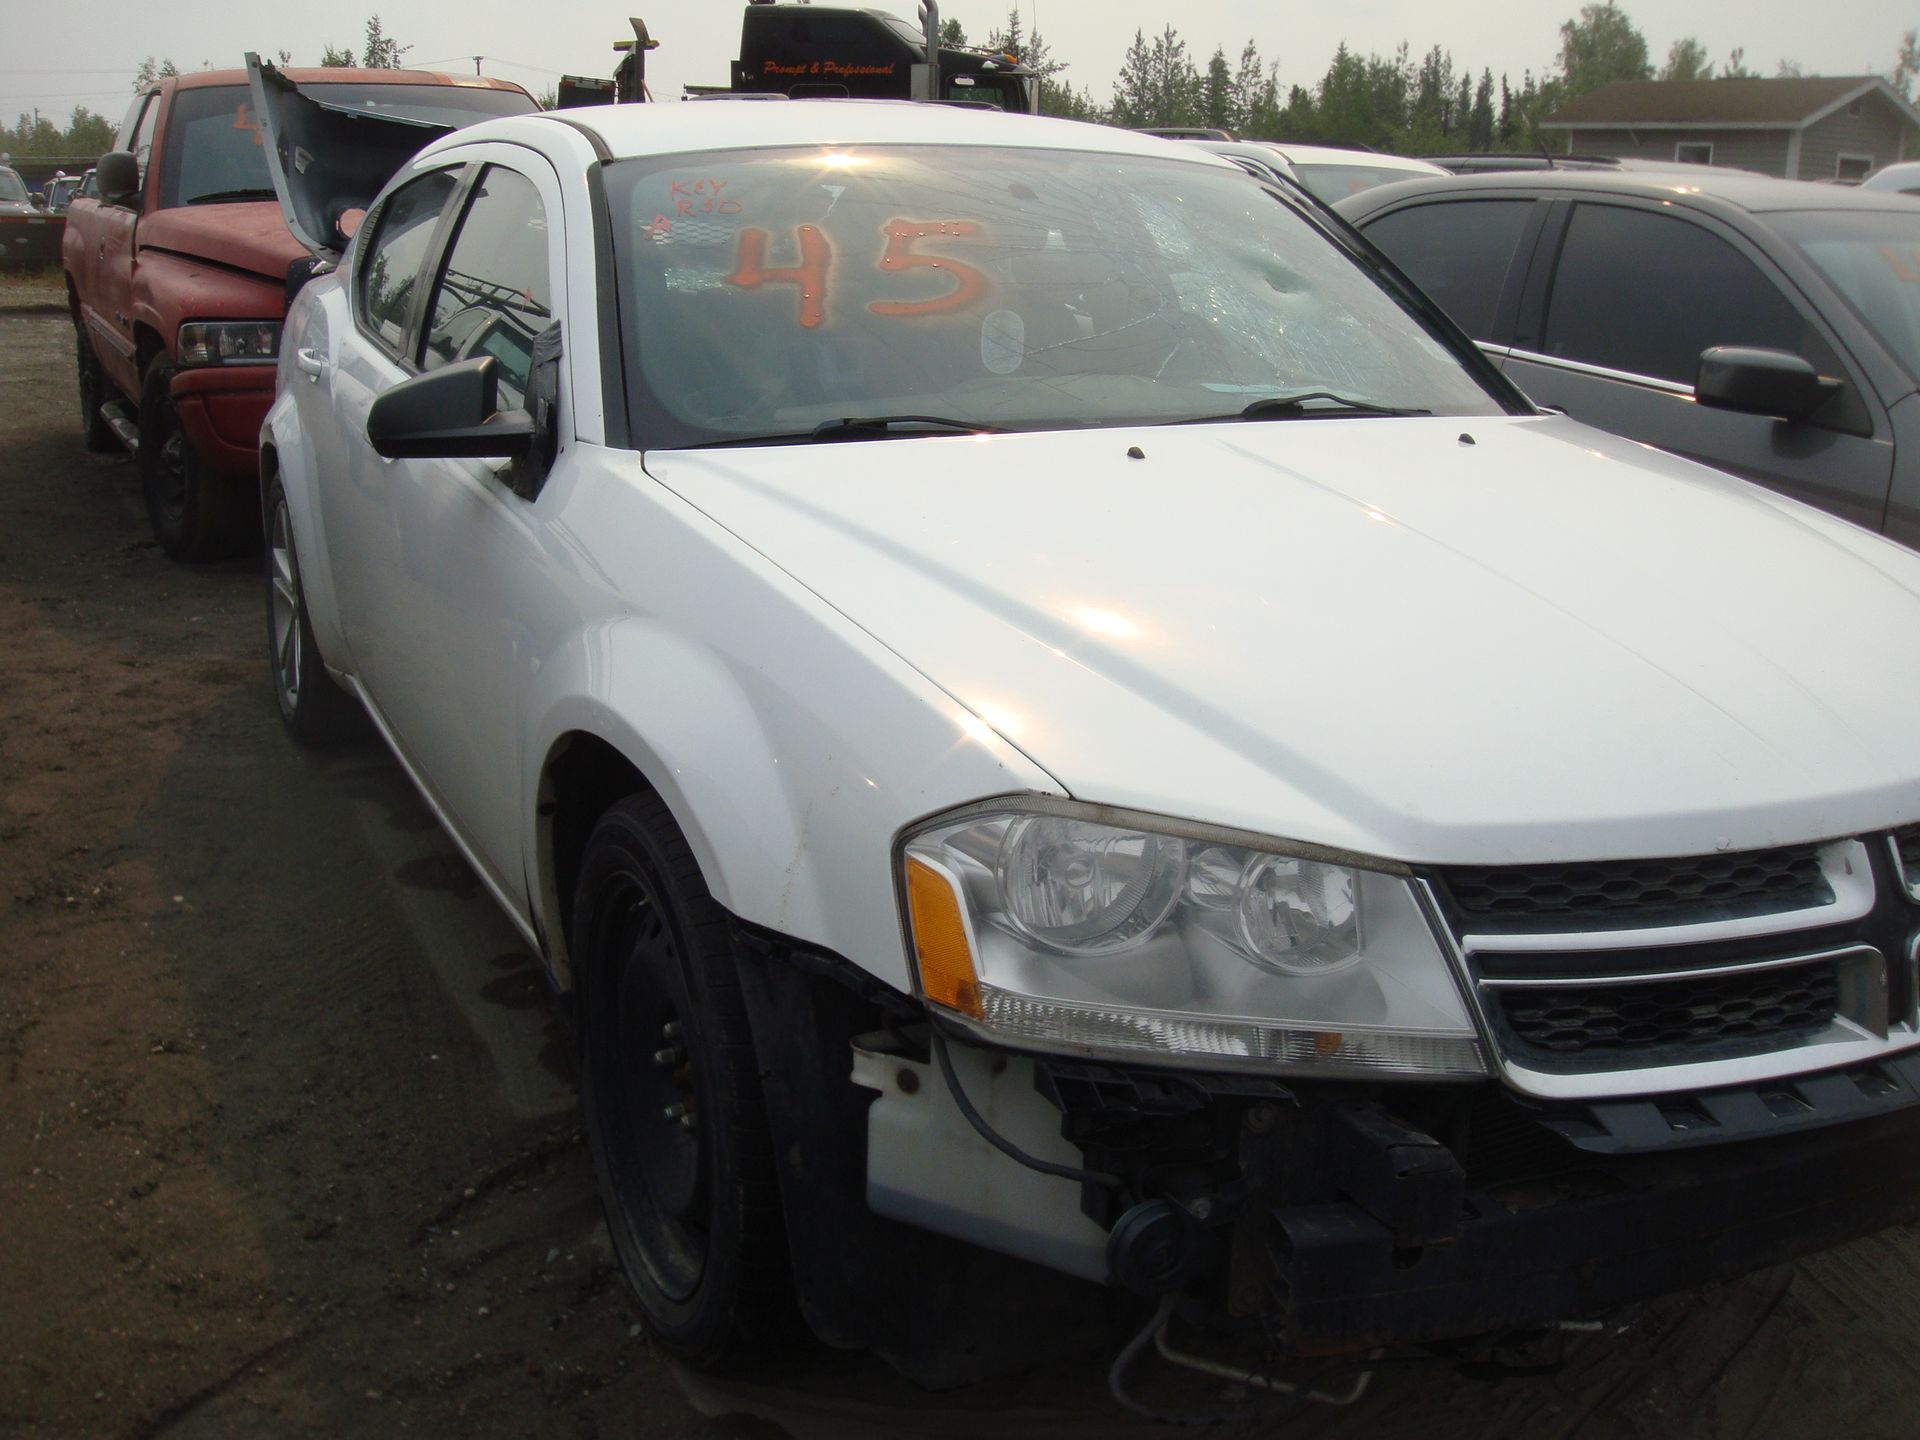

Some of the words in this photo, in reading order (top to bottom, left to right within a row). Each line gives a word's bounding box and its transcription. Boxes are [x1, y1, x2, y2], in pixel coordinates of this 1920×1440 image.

[764, 60, 806, 75] Prompt
[810, 62, 819, 74] &
[824, 61, 894, 77] Professional
[671, 177, 728, 200] KEY
[727, 219, 986, 327] 45
